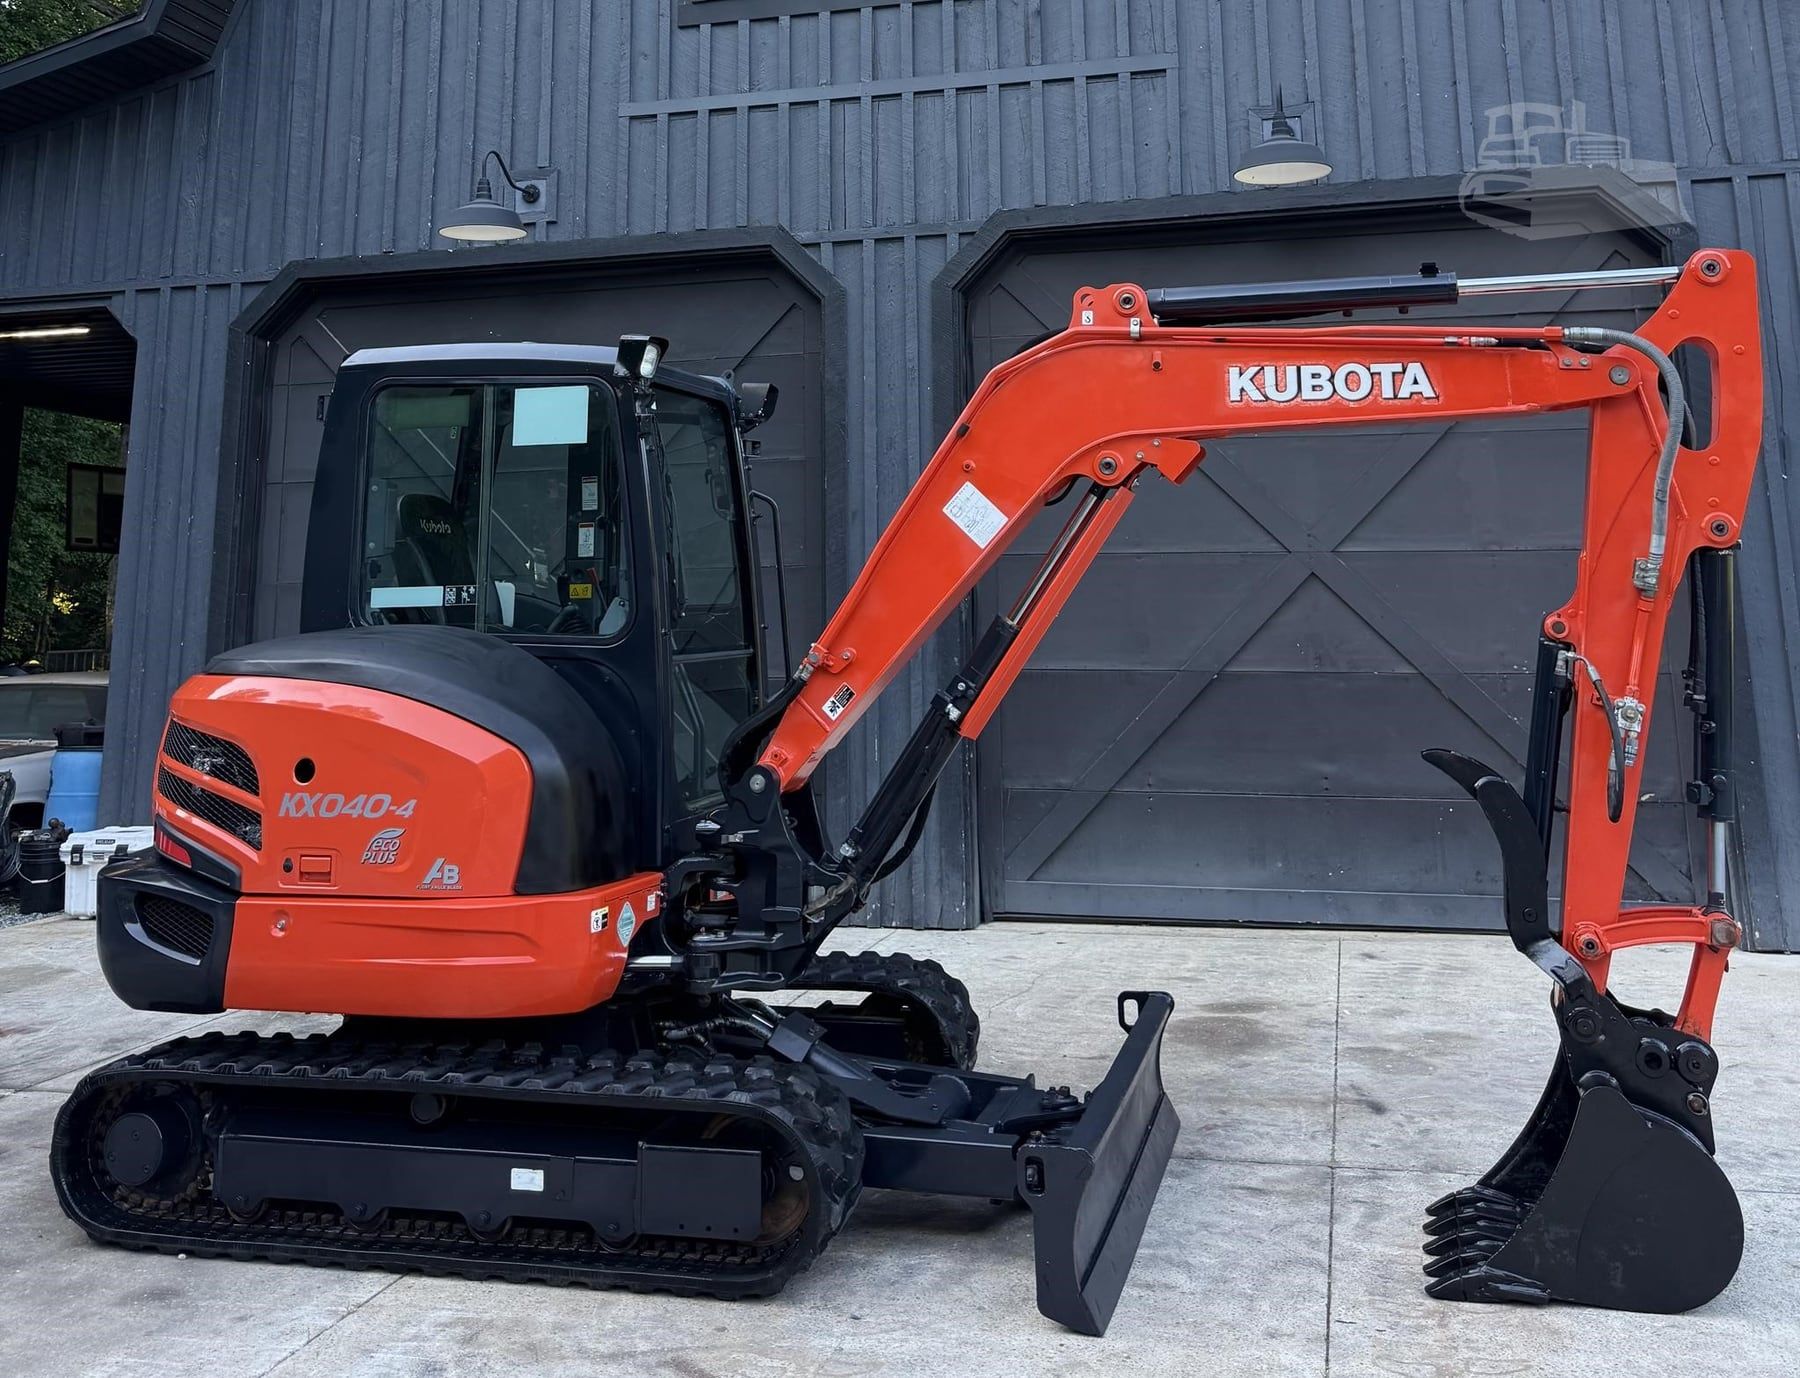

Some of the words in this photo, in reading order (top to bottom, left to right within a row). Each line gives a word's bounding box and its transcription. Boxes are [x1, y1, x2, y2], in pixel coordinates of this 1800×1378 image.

[1228, 362, 1438, 402] KUBOTA
[278, 792, 418, 818] KX040-4
[371, 838, 401, 851] eco
[361, 851, 398, 865] PLUS
[422, 857, 460, 885] AB
